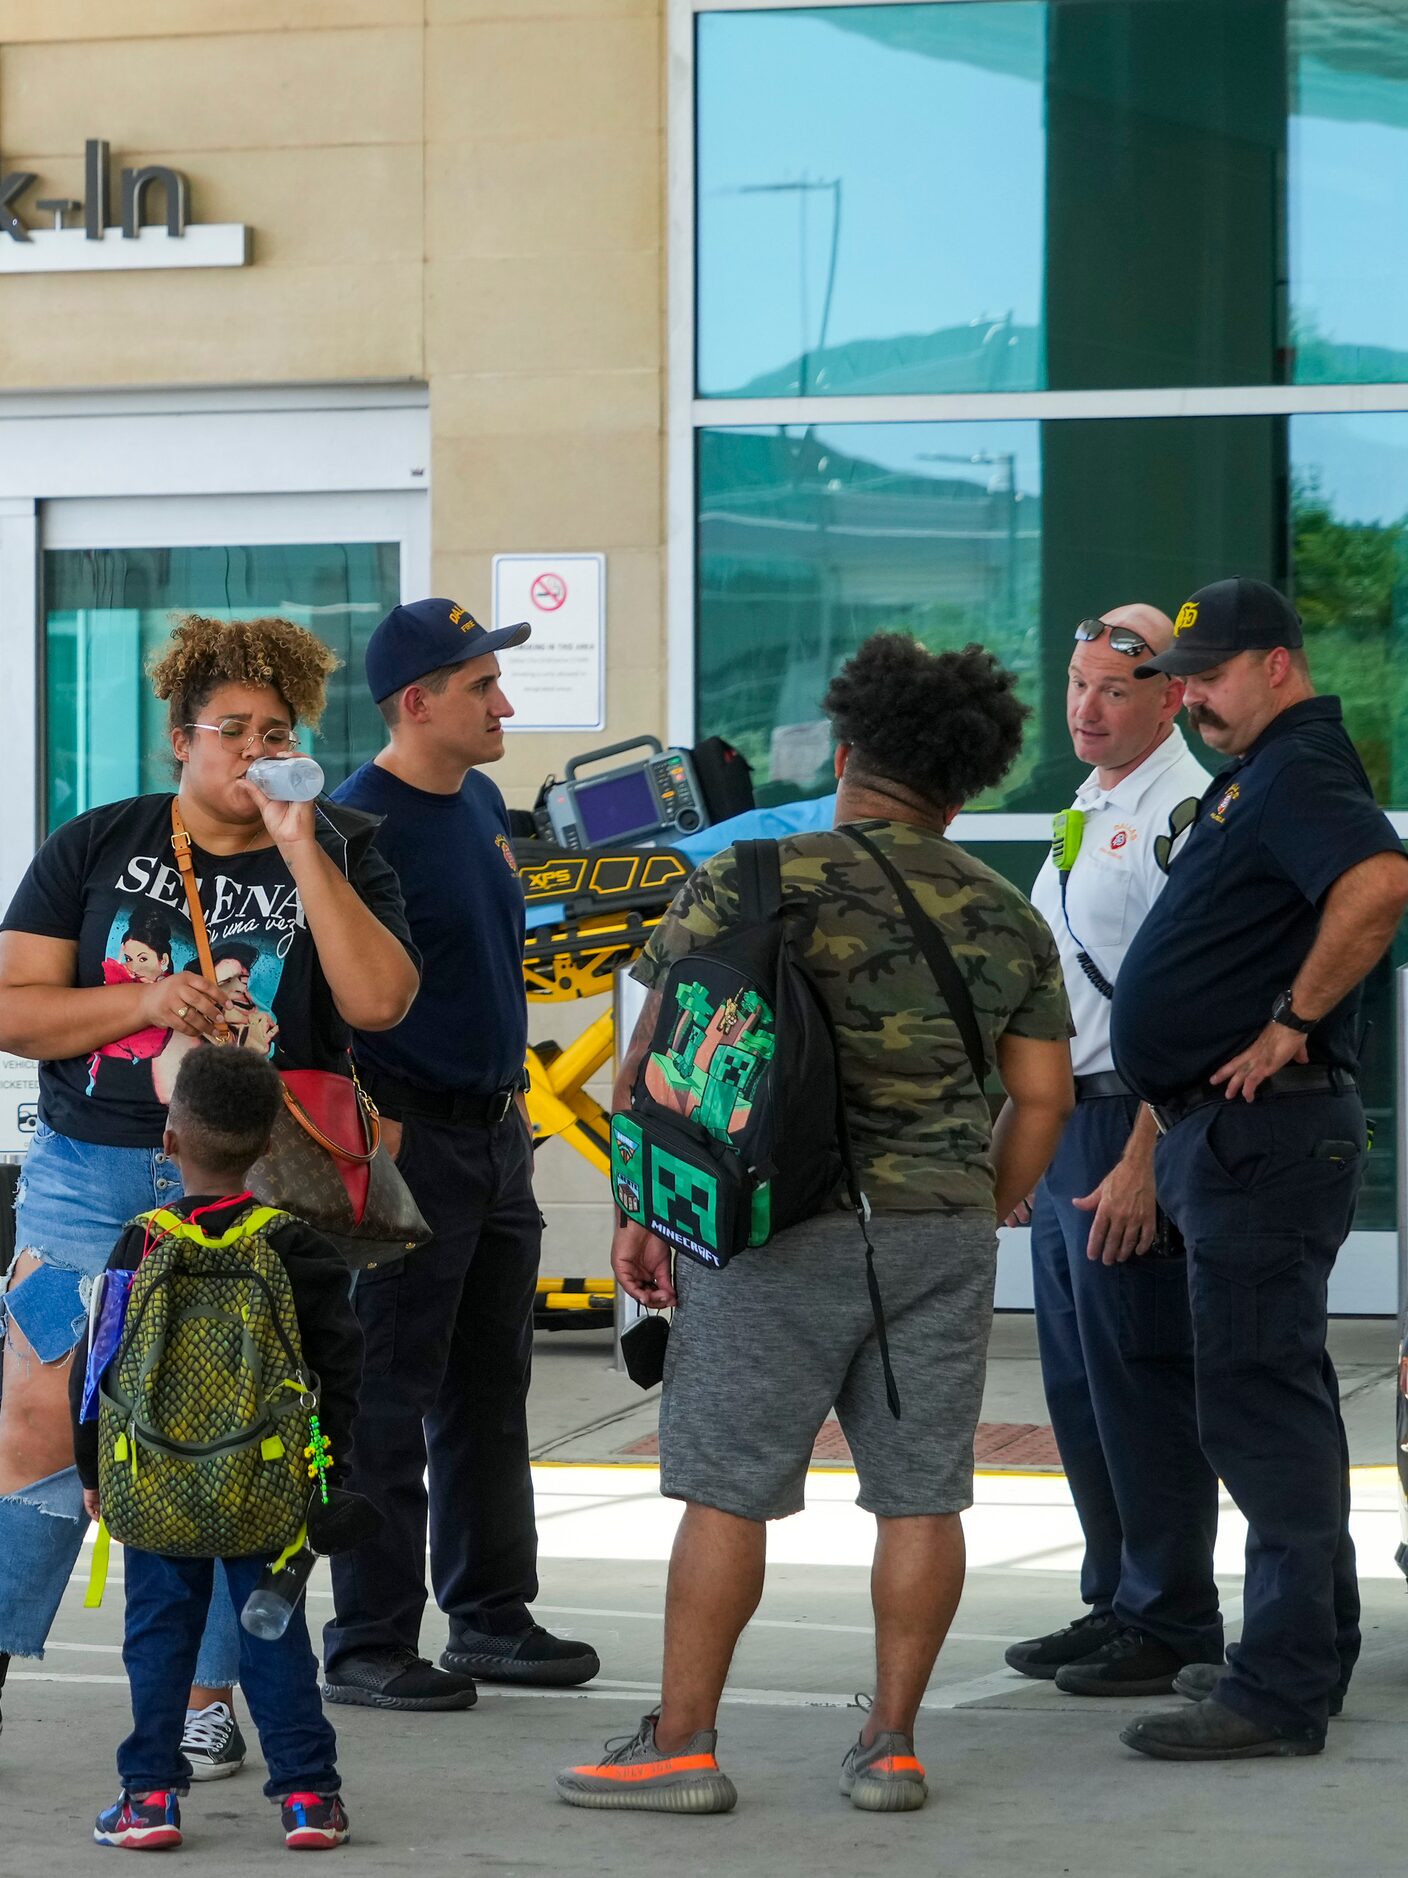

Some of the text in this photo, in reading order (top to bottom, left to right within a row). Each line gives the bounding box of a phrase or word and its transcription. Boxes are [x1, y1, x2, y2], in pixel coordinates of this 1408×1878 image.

[528, 869, 570, 887] XPS
[223, 918, 260, 939] una
[265, 917, 296, 959] vez
[2, 1060, 38, 1069] VEHICL
[651, 1219, 720, 1267] MINECRAFT
